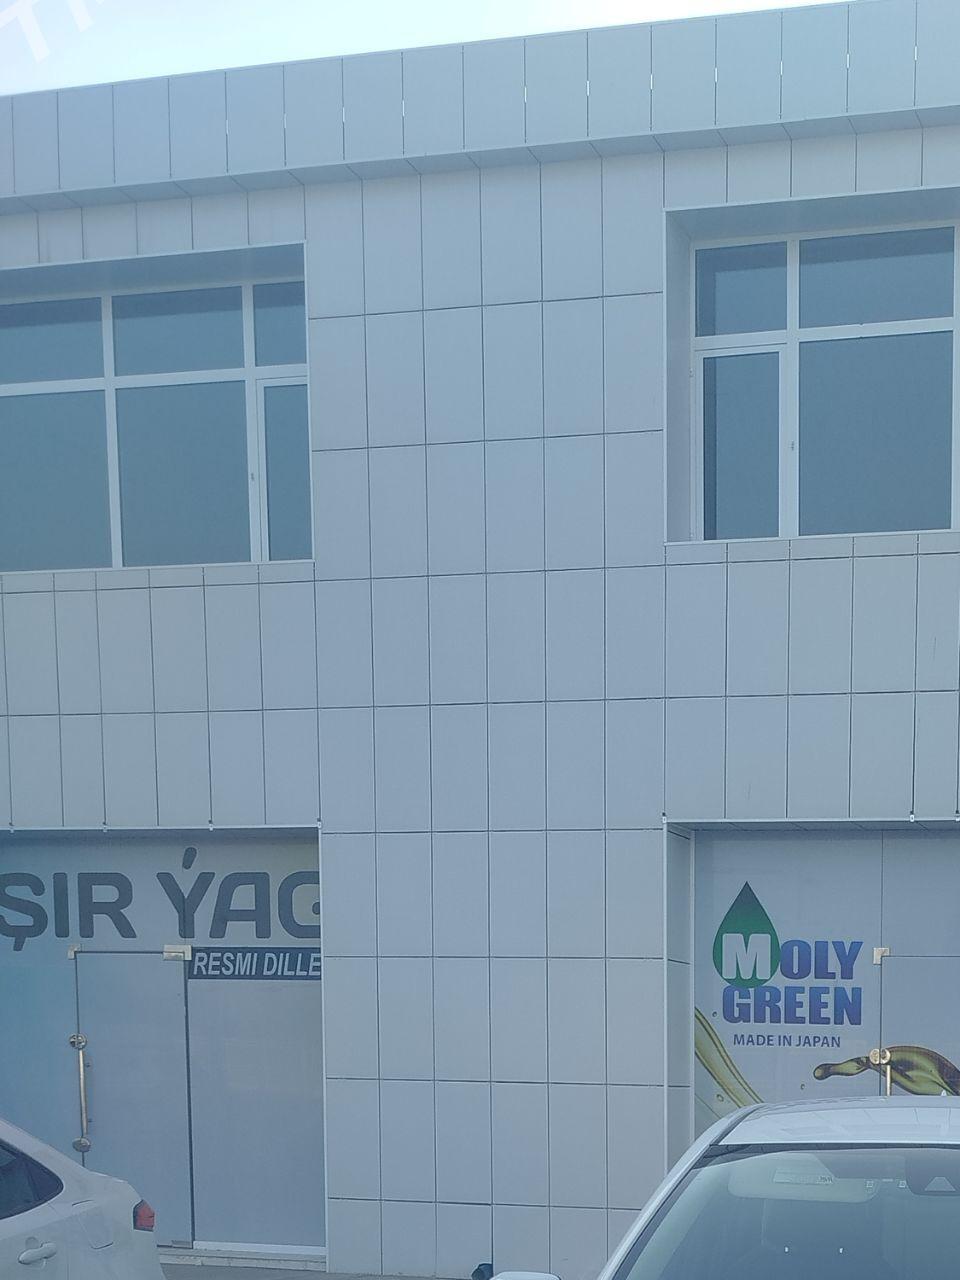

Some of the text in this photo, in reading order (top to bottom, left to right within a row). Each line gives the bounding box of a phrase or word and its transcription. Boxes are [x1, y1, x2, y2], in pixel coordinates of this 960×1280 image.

[0, 871, 138, 952] ŞIR
[193, 951, 321, 976] RESMI DILLE
[722, 933, 864, 981] MOLY
[722, 985, 863, 1026] GREEN
[733, 1034, 841, 1048] MADE IN JAPAN
